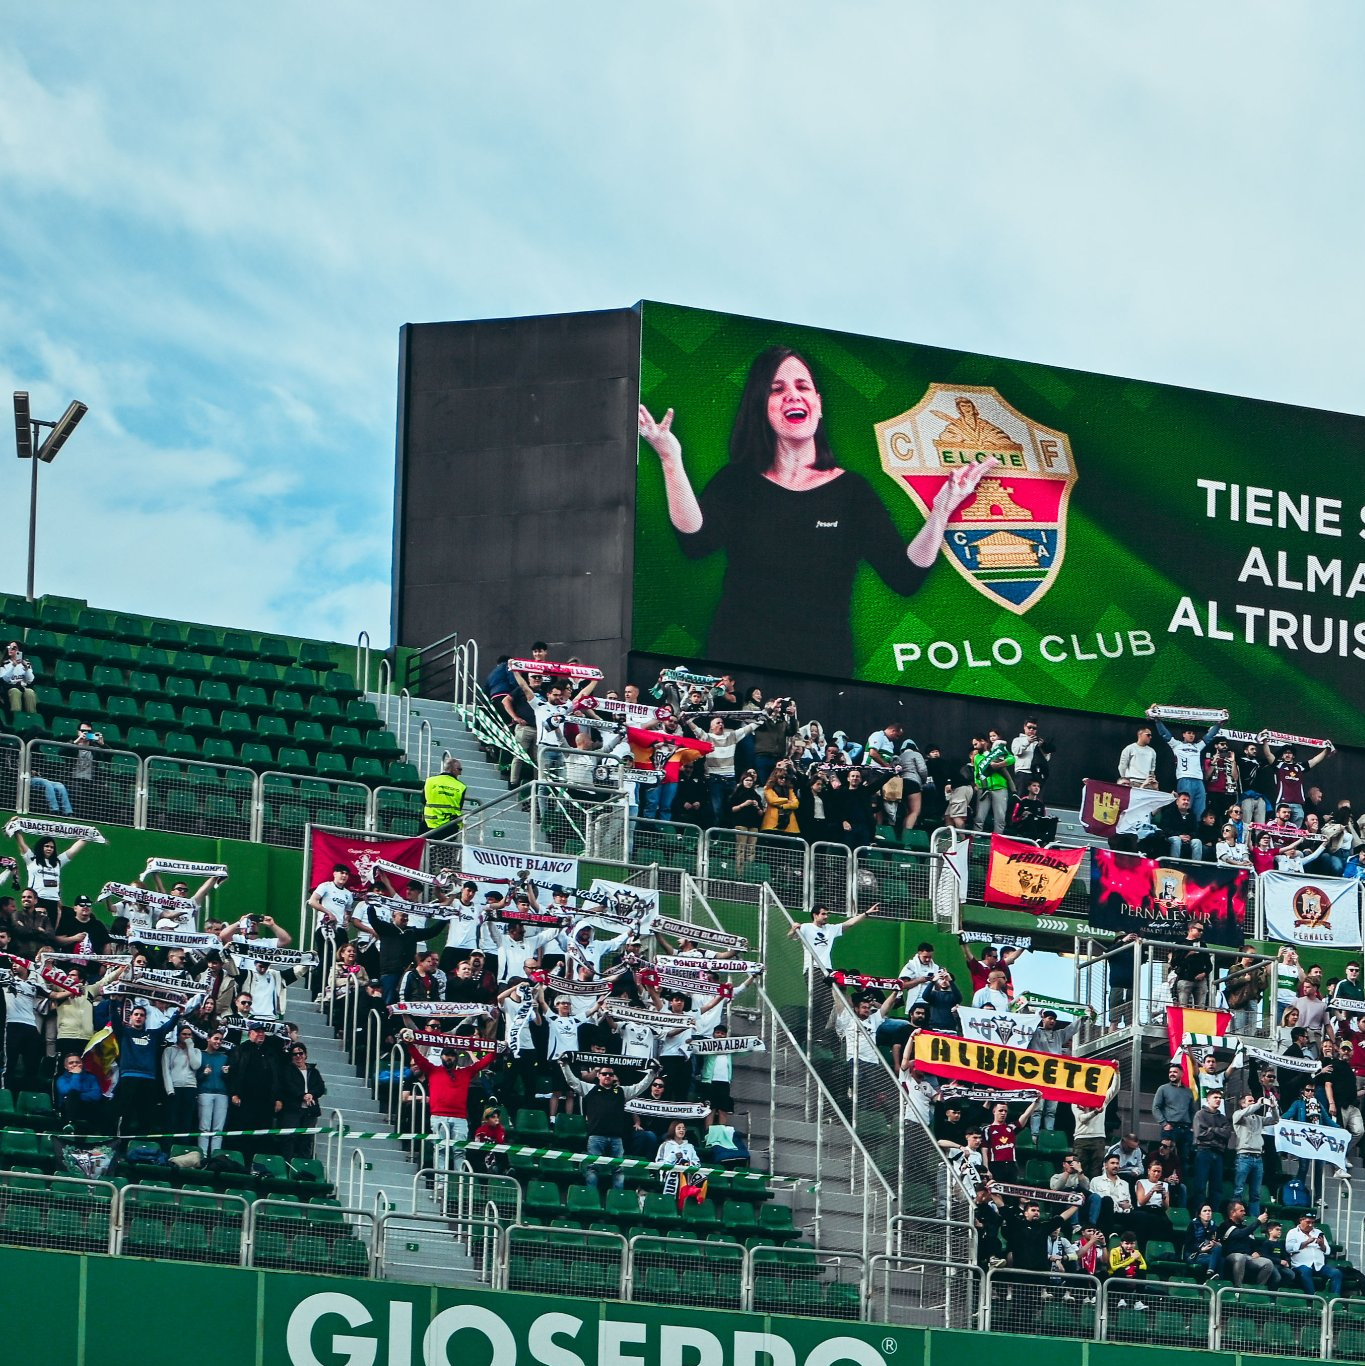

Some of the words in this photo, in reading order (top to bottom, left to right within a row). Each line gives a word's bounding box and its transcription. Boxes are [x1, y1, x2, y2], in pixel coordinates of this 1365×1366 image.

[1198, 478, 1343, 538] TIENE
[895, 636, 1023, 674] POLO
[1039, 630, 1156, 665] CLUB
[20, 820, 52, 833] ALBACETE
[472, 849, 521, 870] QUIJOTE
[525, 859, 574, 872] BLANCO
[1007, 853, 1069, 873] PERNALES
[1120, 904, 1187, 923] PERNALES
[139, 931, 173, 943] ALBACETE
[664, 922, 700, 939] QUIJOTE
[700, 931, 736, 944] BLANCO
[1077, 923, 1116, 937] SALIDA
[866, 980, 900, 990] ALBA
[415, 1033, 471, 1048] PERNALES
[474, 1039, 496, 1050] SUR
[575, 1053, 607, 1064] ALBACETE
[931, 1038, 1099, 1092] ALBACETE
